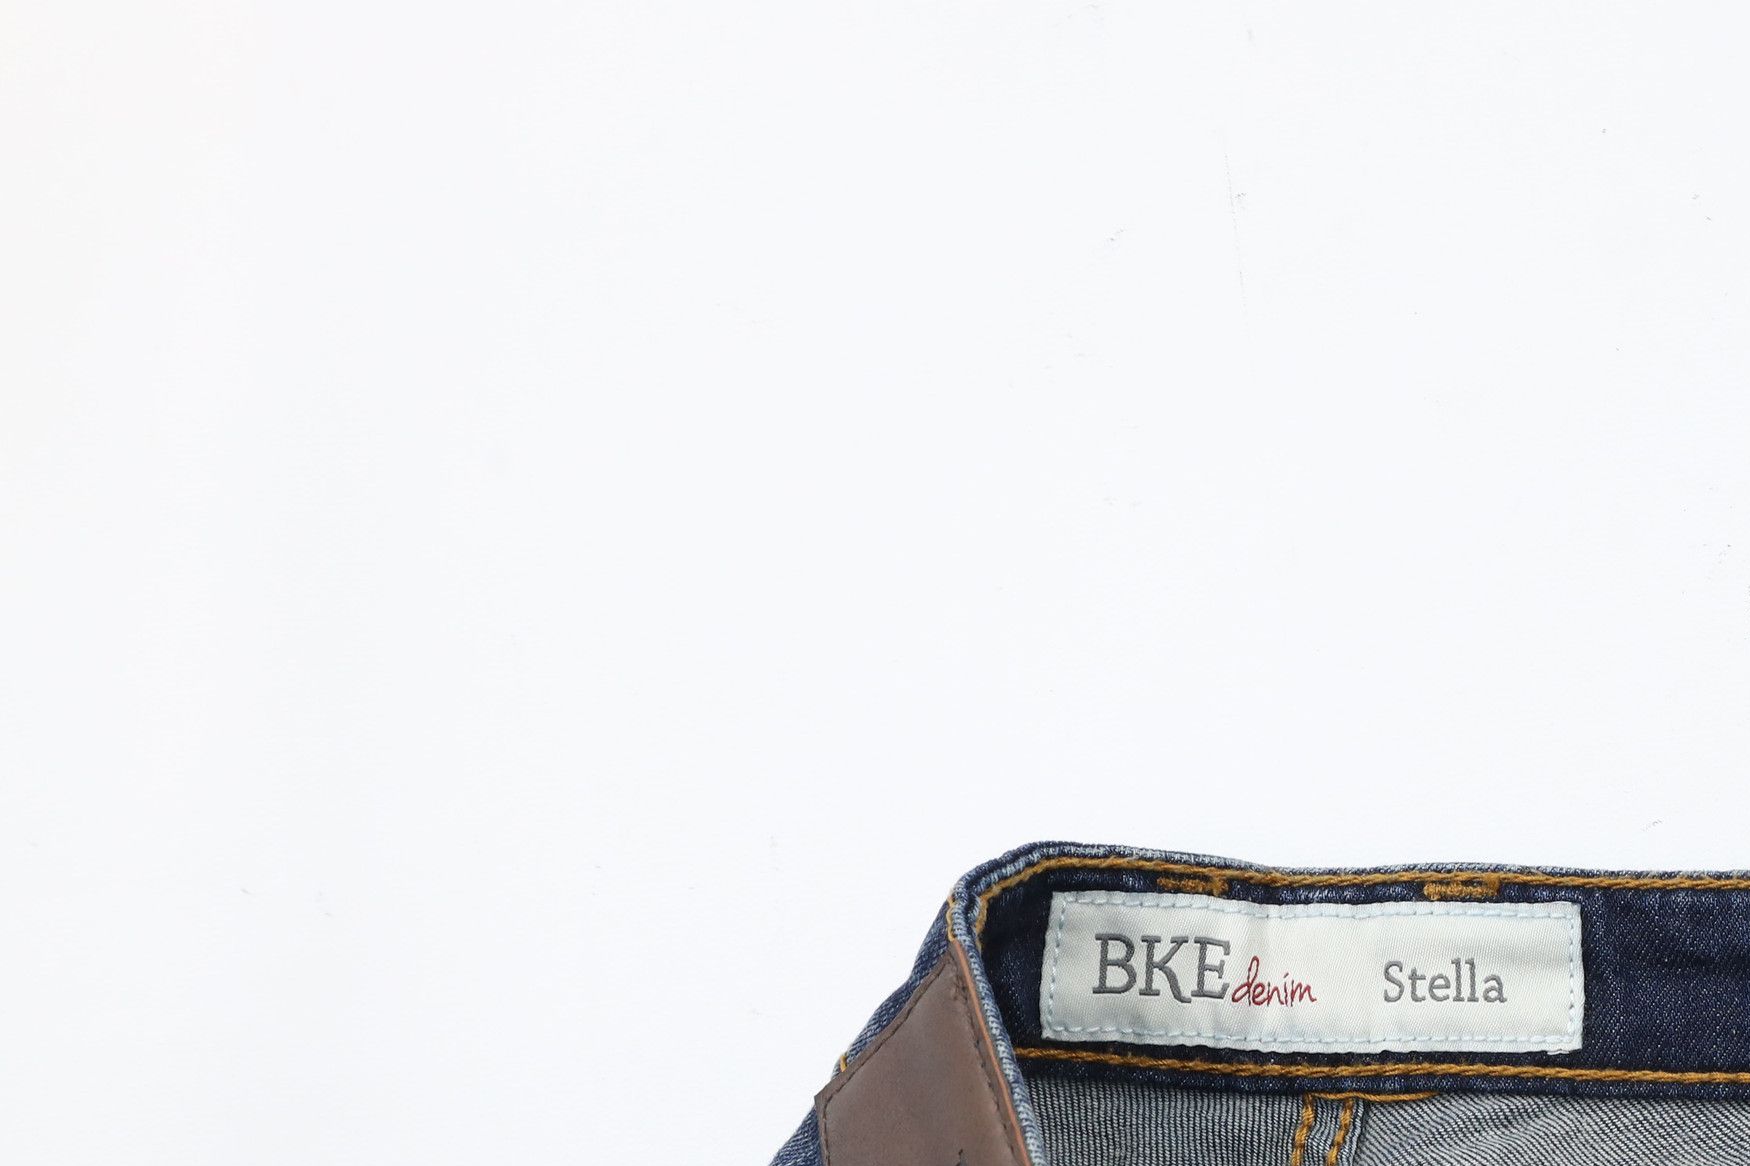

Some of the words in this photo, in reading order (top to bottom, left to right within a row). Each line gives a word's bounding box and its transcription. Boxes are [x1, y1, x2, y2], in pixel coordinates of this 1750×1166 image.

[1092, 932, 1231, 1005] BKE
[1231, 955, 1318, 1009] denim
[1382, 957, 1508, 1004] Stella
